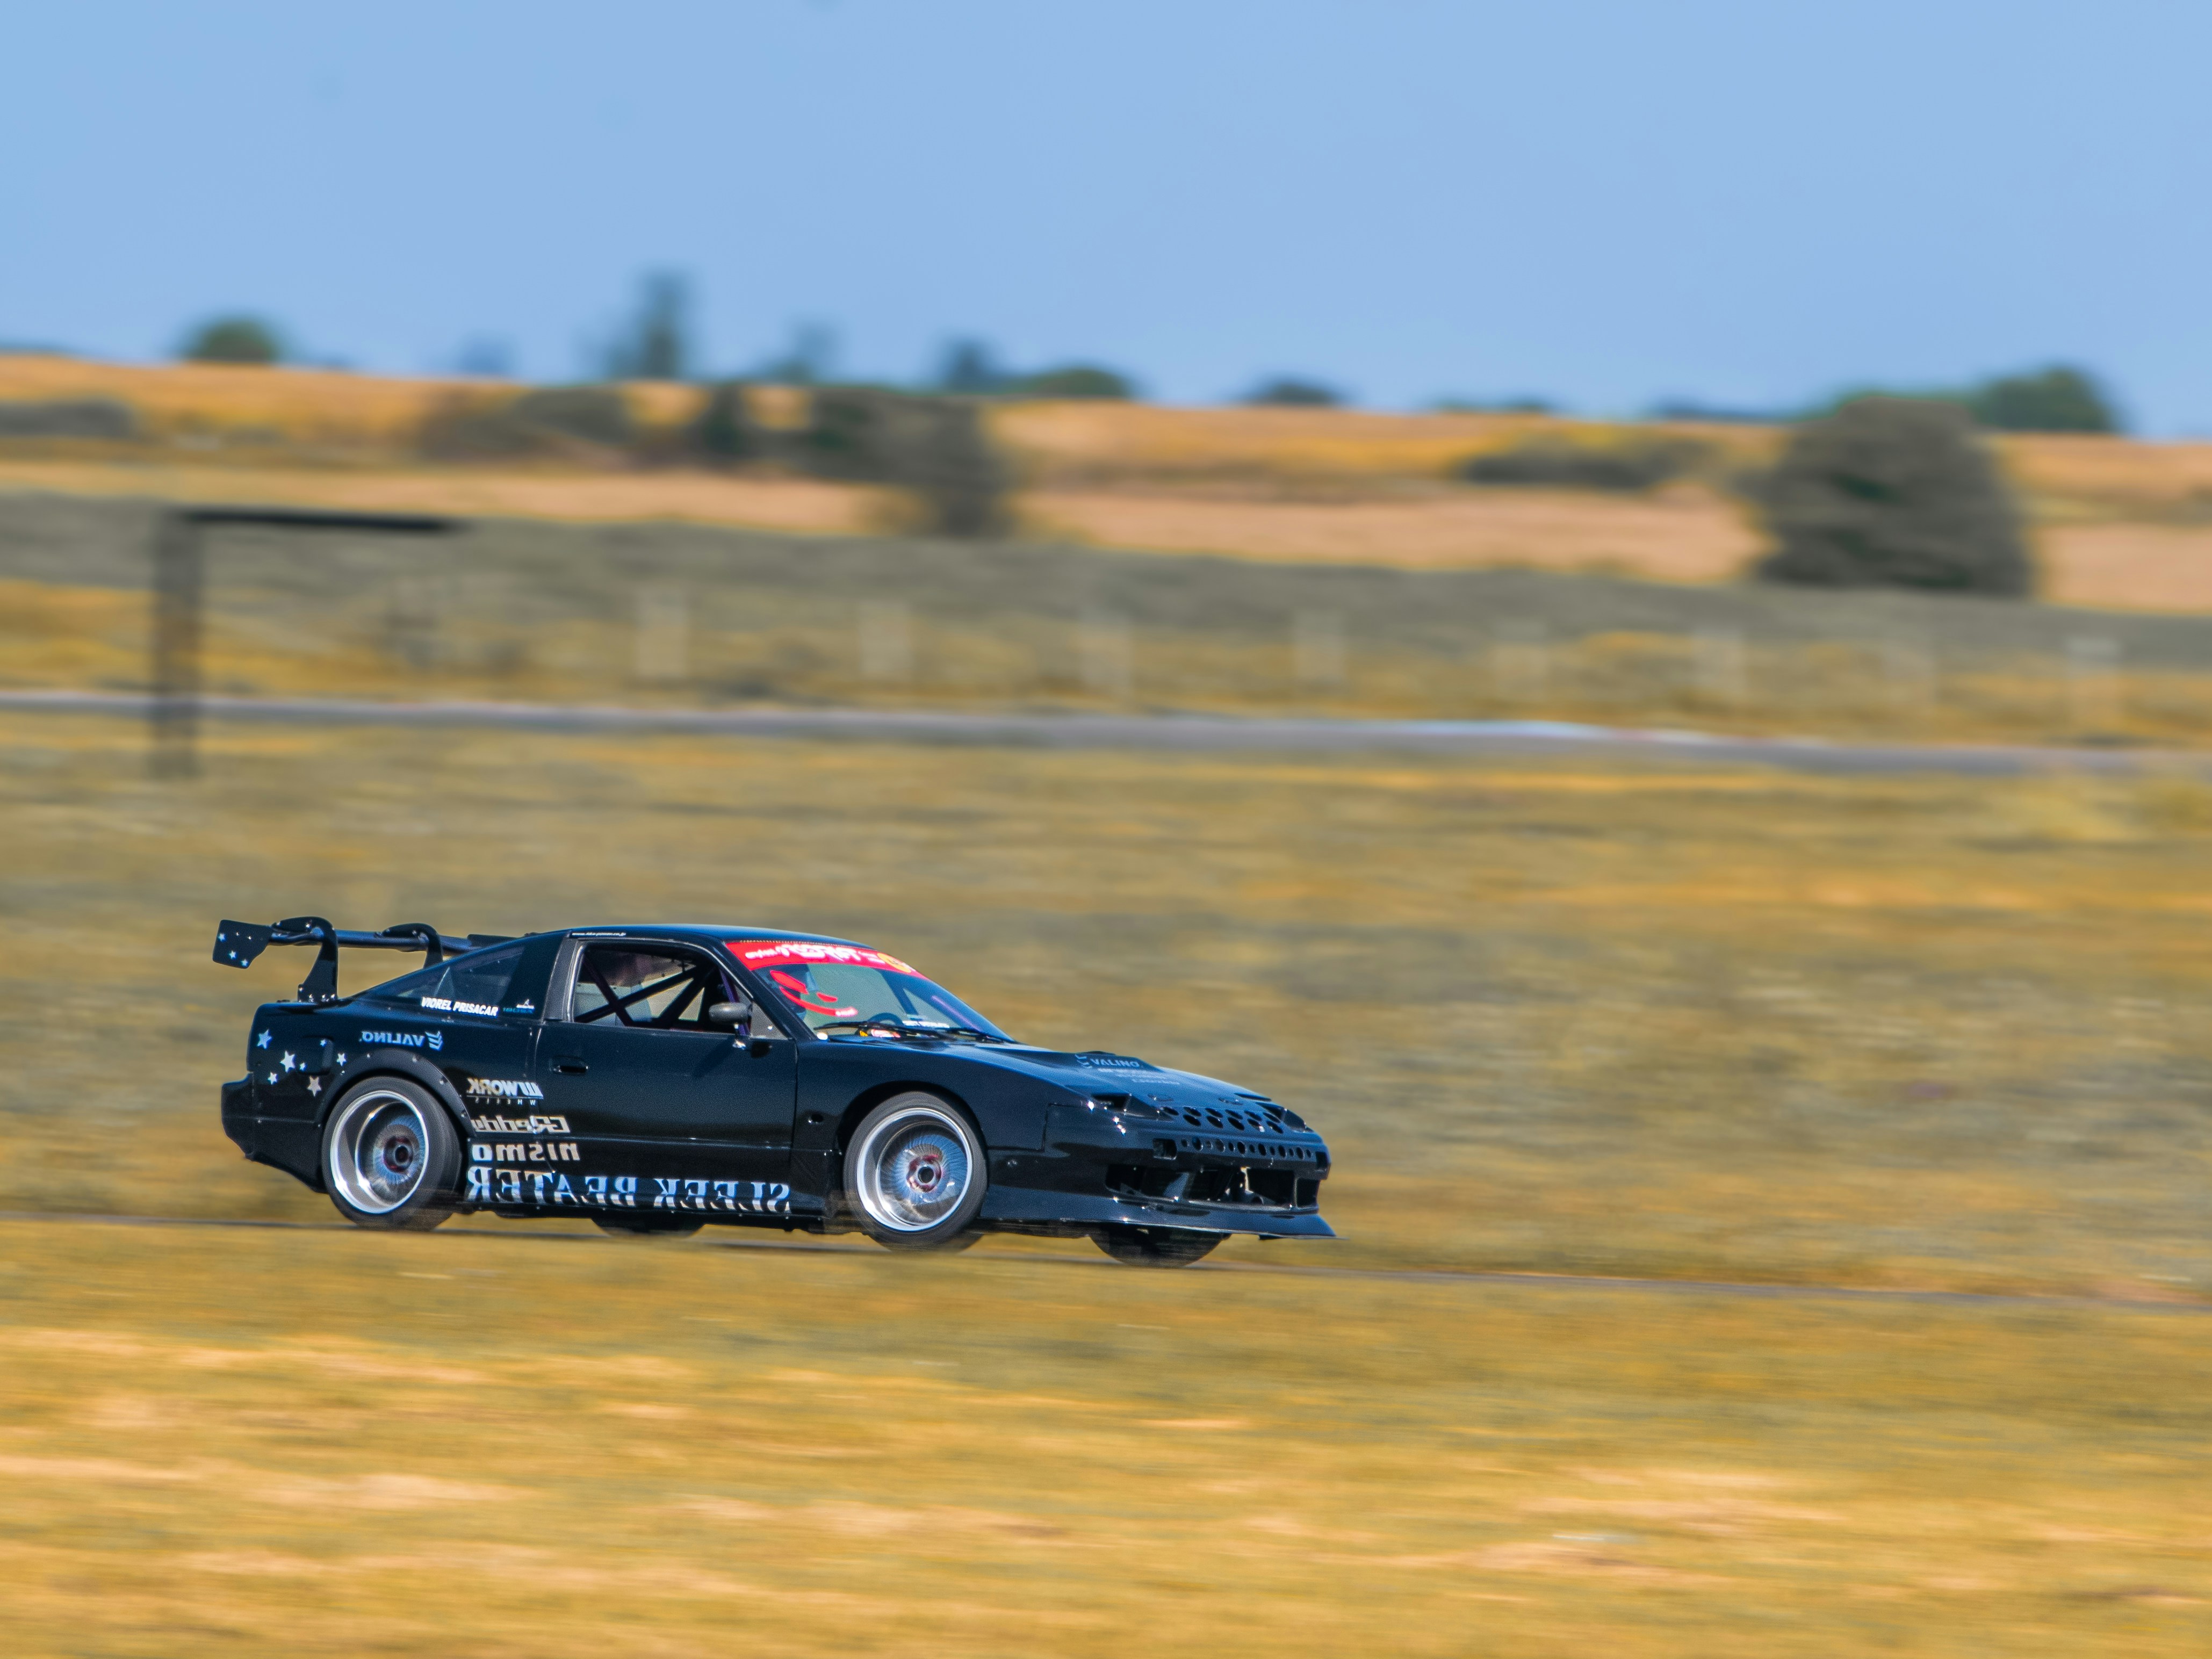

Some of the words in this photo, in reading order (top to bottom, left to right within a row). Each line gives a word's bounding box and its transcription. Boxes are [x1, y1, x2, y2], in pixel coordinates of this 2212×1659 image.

[421, 997, 452, 1011] VIOREL
[453, 1001, 499, 1016] PRISACAR
[1090, 1058, 1140, 1067] VALINO
